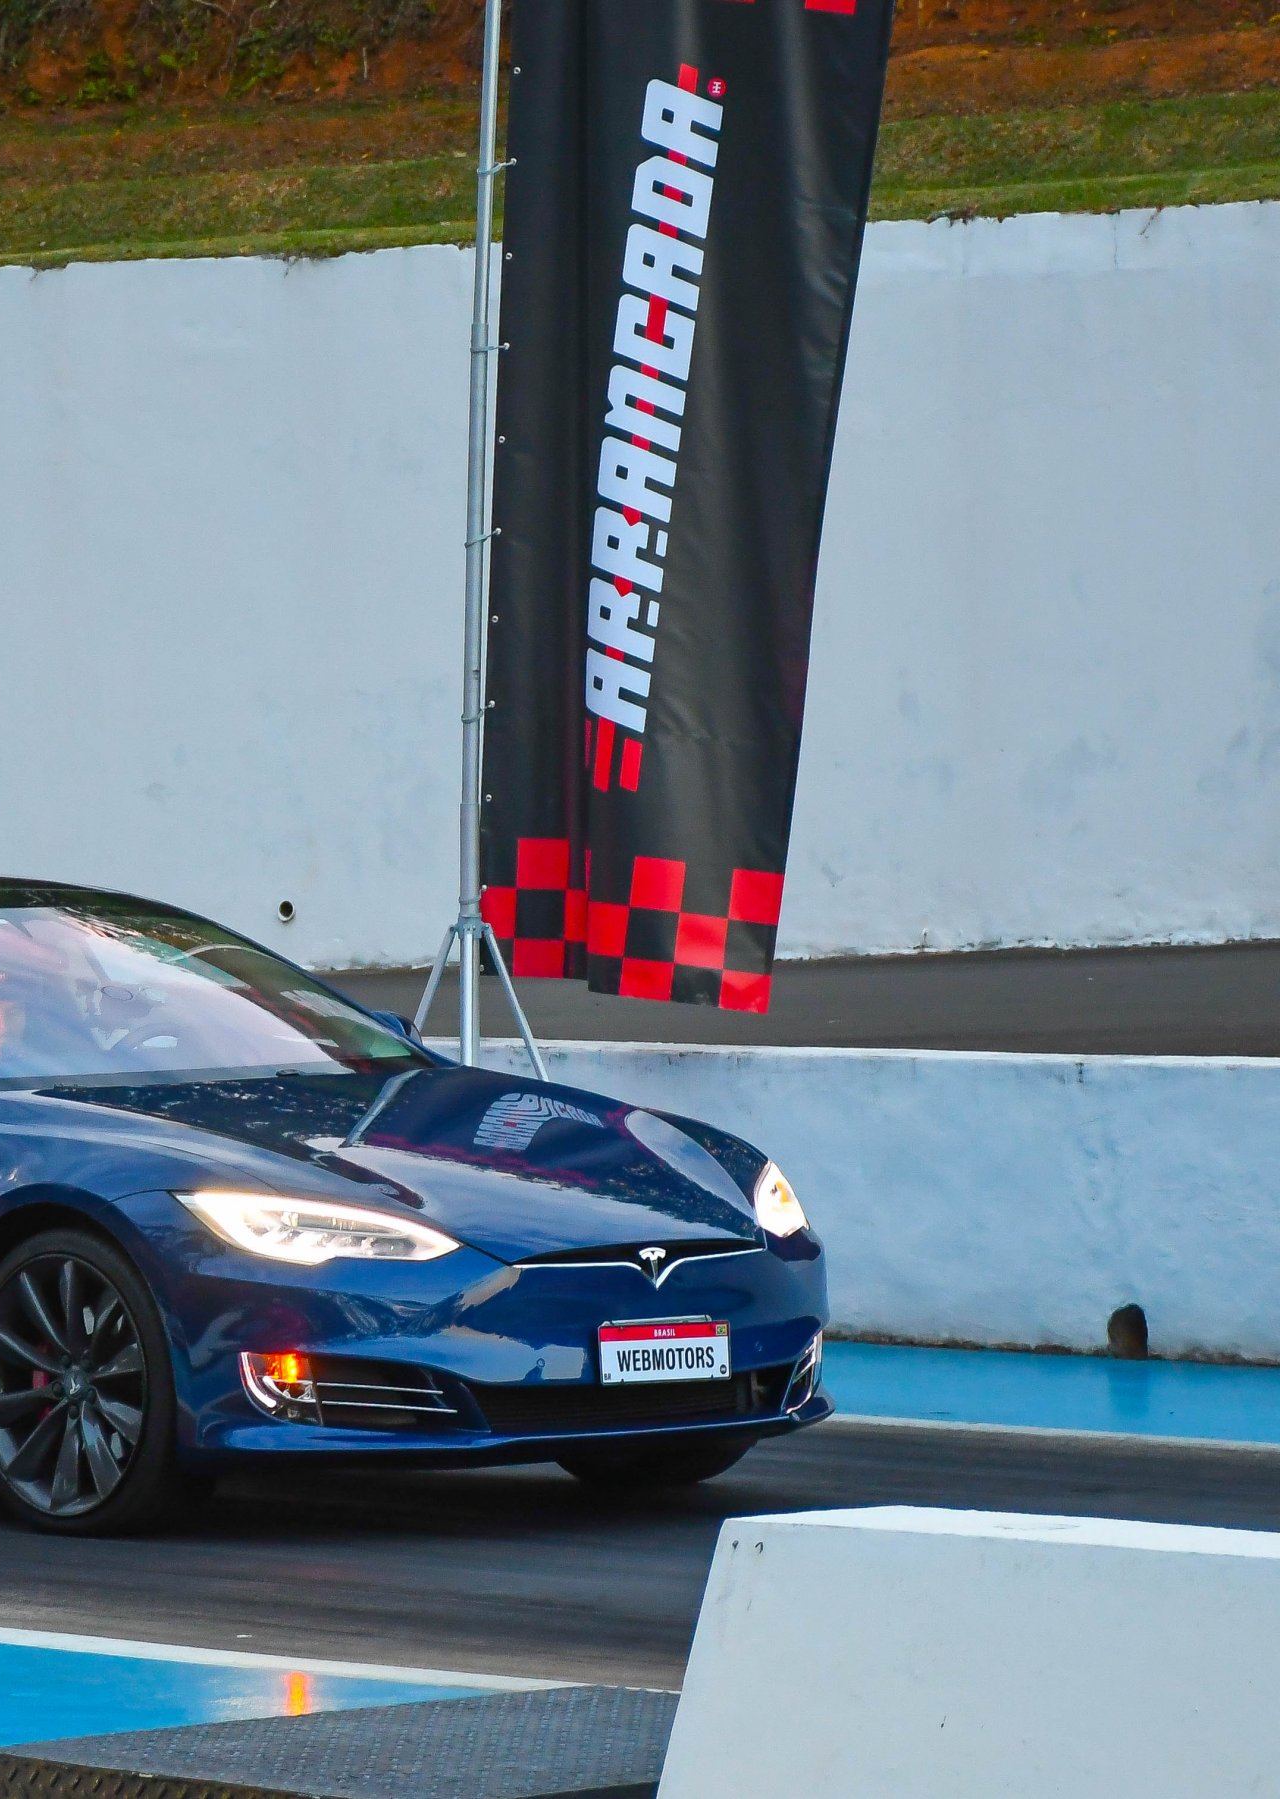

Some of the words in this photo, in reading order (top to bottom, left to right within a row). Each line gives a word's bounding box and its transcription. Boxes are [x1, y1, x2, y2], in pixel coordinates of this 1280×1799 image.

[586, 78, 723, 734] ARRANCADA
[653, 1329, 676, 1337] BRASIL
[616, 1346, 715, 1372] WEBMOTORS
